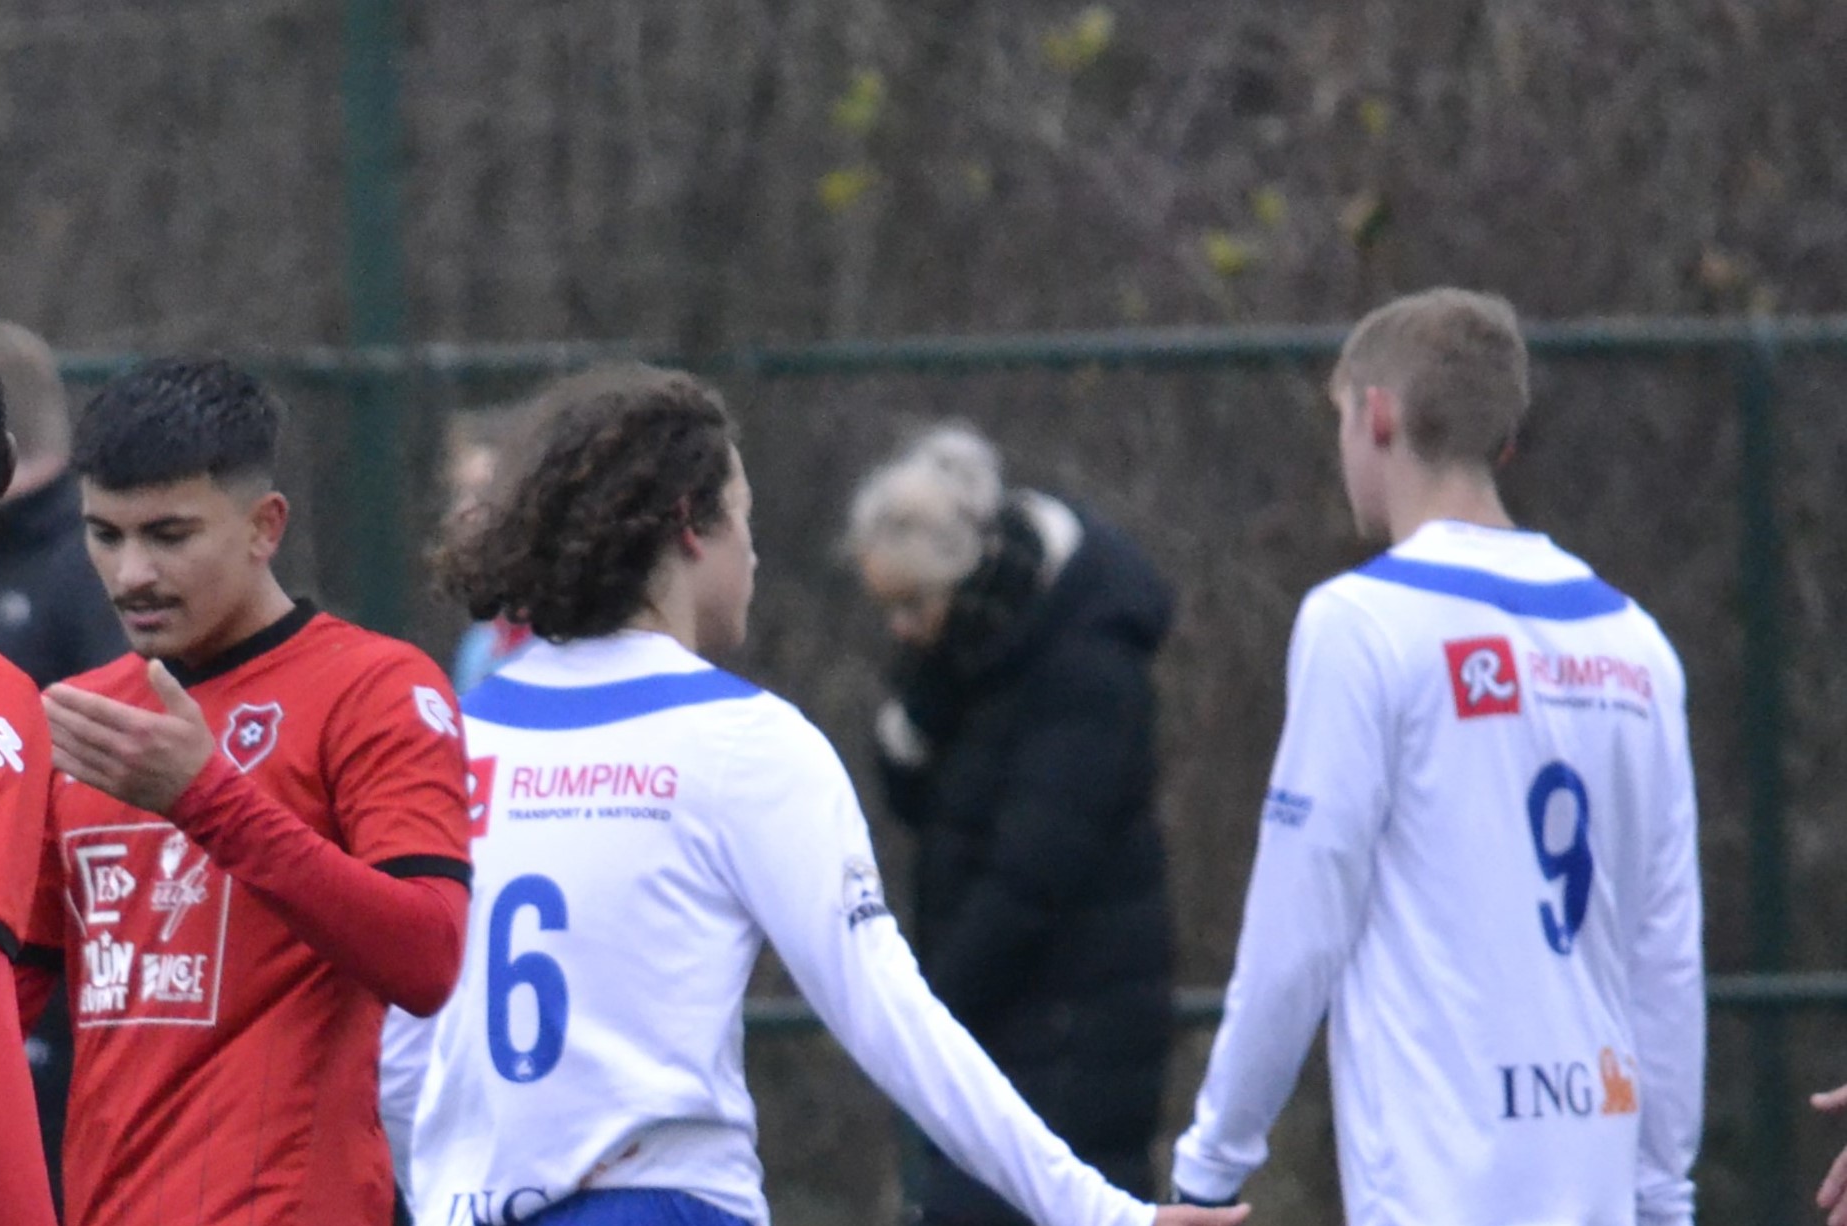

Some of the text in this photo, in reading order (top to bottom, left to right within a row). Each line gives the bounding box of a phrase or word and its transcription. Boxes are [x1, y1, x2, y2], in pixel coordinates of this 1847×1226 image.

[510, 763, 679, 800] RUMPING
[1527, 760, 1595, 956] 9
[486, 873, 569, 1084] 6
[1498, 1063, 1594, 1120] ING
